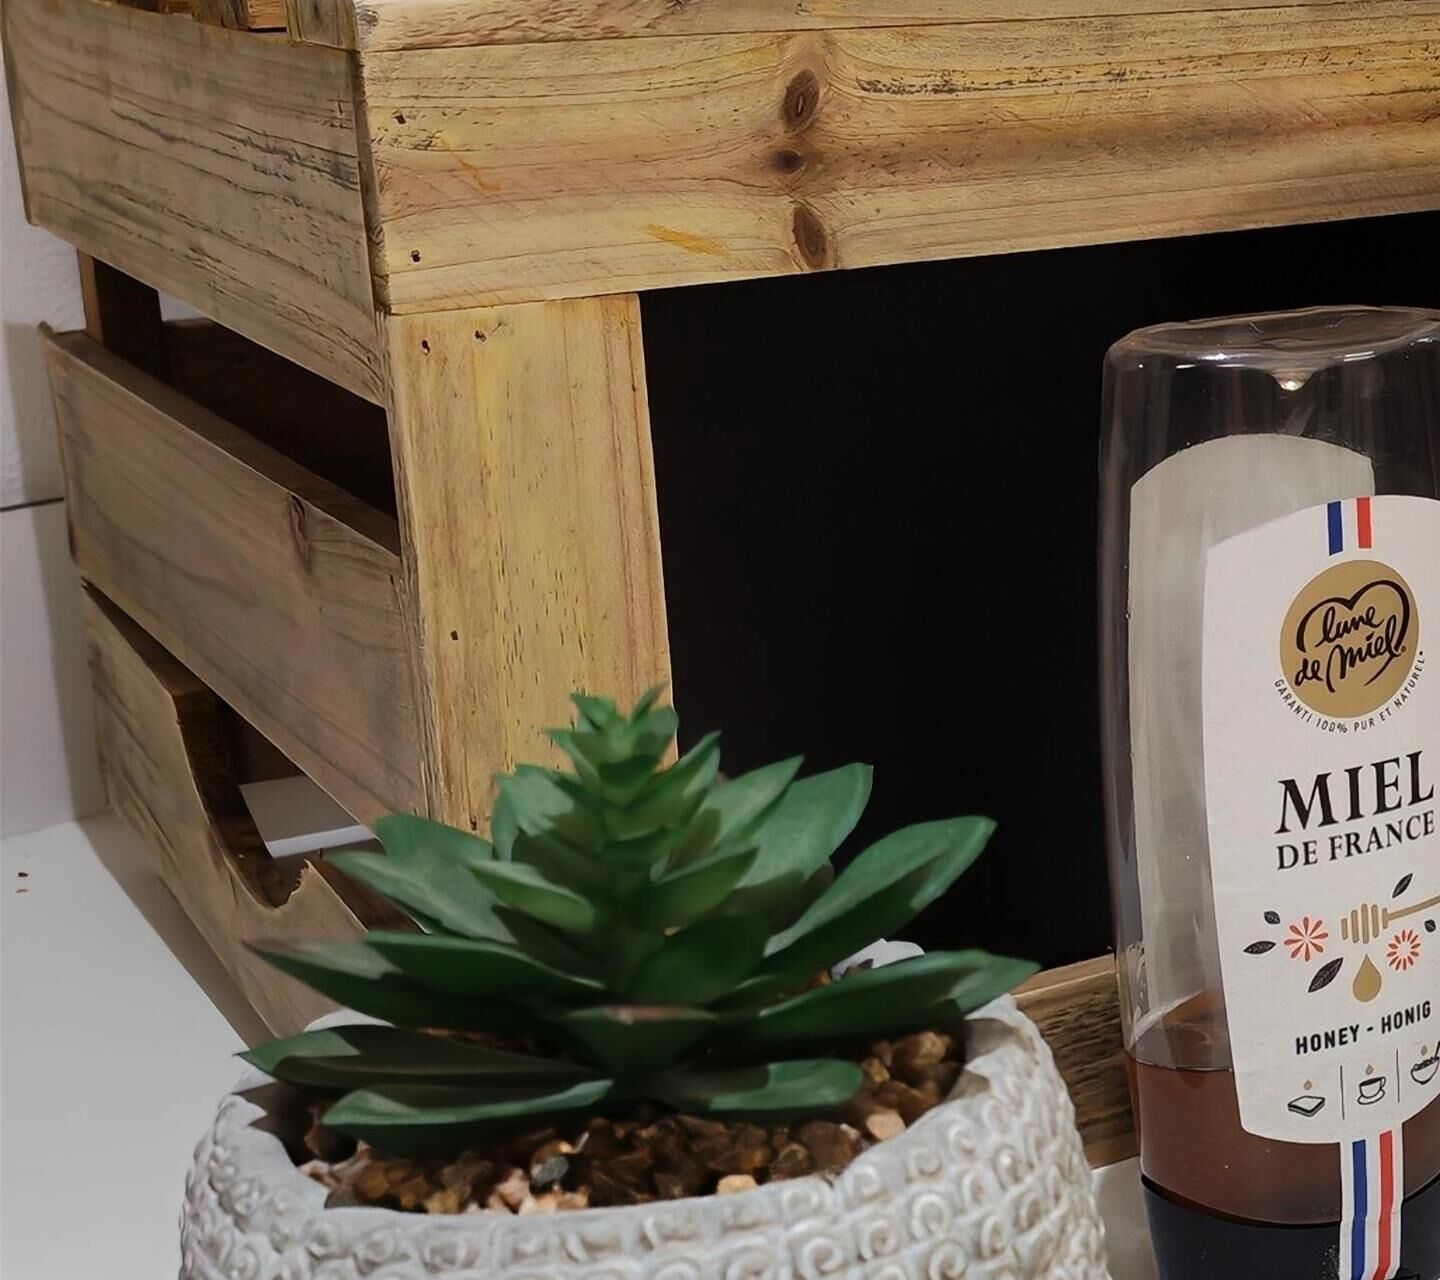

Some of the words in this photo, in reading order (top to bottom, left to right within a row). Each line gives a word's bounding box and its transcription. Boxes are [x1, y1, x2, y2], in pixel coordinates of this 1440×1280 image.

[1294, 658, 1323, 686] de
[1274, 679, 1313, 723] GARANTI
[1316, 718, 1348, 733] 100%
[1353, 718, 1375, 732] PUR
[1380, 708, 1392, 722] ET
[1274, 750, 1435, 834] MIEL
[1277, 839, 1319, 870] DE
[1328, 810, 1435, 861] FRANCE
[1295, 1023, 1361, 1055] HONEY
[1380, 1000, 1432, 1035] HONIG
